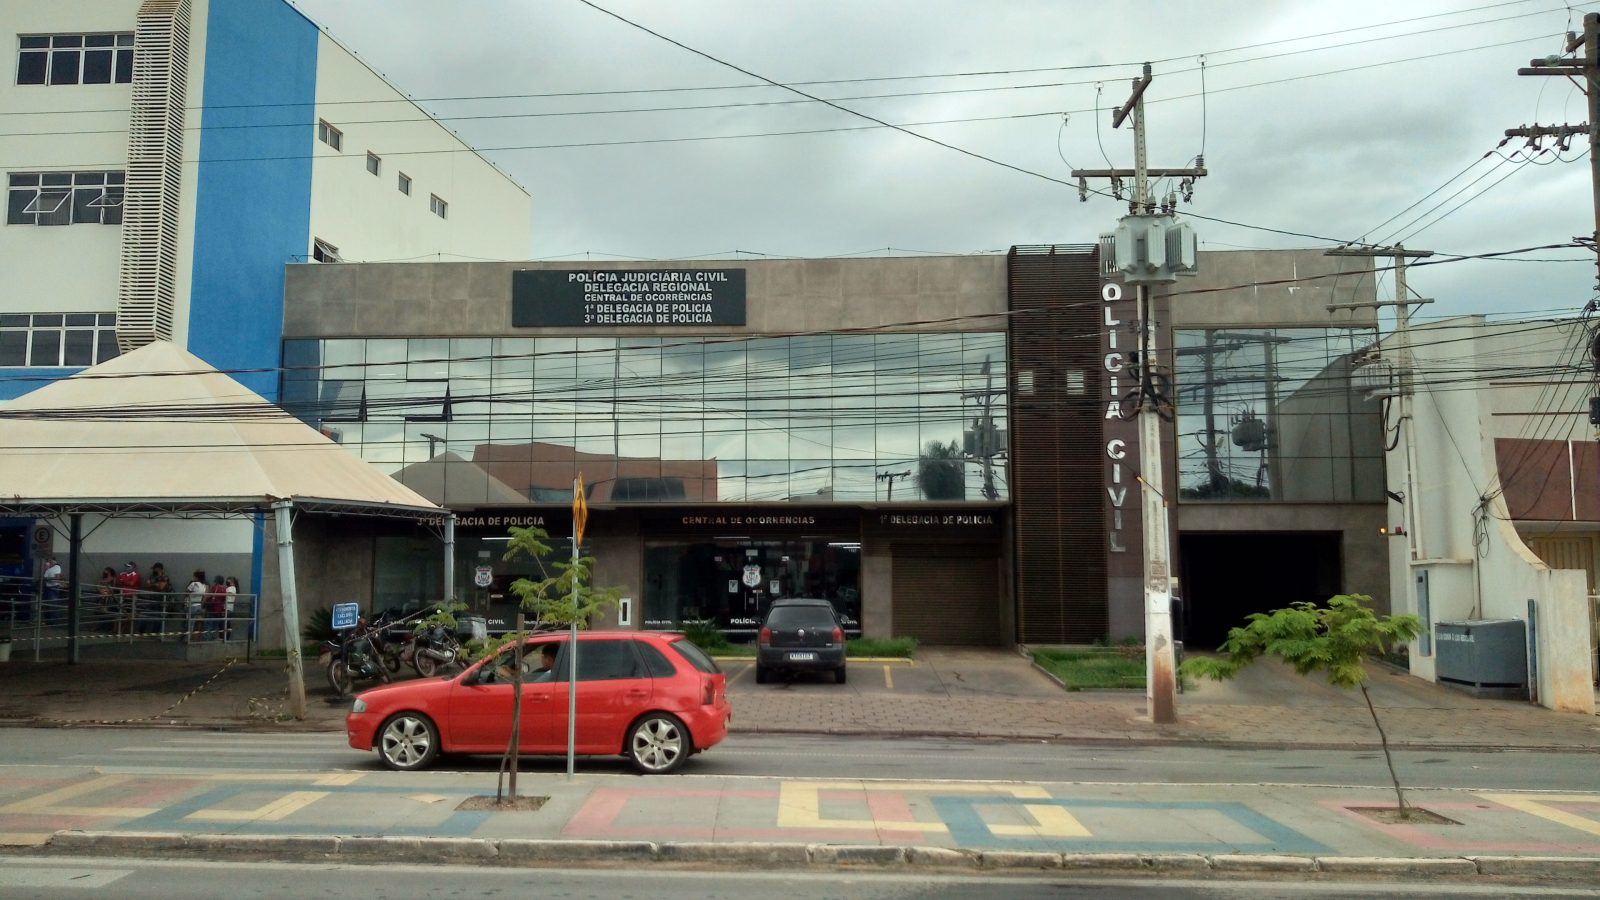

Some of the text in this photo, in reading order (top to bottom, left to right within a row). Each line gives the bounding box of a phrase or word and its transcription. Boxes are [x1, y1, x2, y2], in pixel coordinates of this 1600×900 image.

[569, 271, 727, 282] POLÍCIA JUDICIÁRIA CIVIL
[584, 282, 712, 292] DELEGACIA REGIONAL
[645, 292, 712, 301] OCORRÊNCIAS
[597, 304, 653, 313] DELEGACIA
[656, 304, 669, 313] DE
[672, 303, 712, 313] POLICIA
[597, 314, 653, 323] DELEGACIA
[656, 314, 669, 323] DE
[673, 314, 712, 323] POLICIA
[1102, 260, 1124, 418] OLICIA
[1106, 439, 1126, 552] CIVIL
[429, 516, 485, 526] DELGACIA
[488, 516, 501, 525] DE
[943, 515, 954, 524] DE
